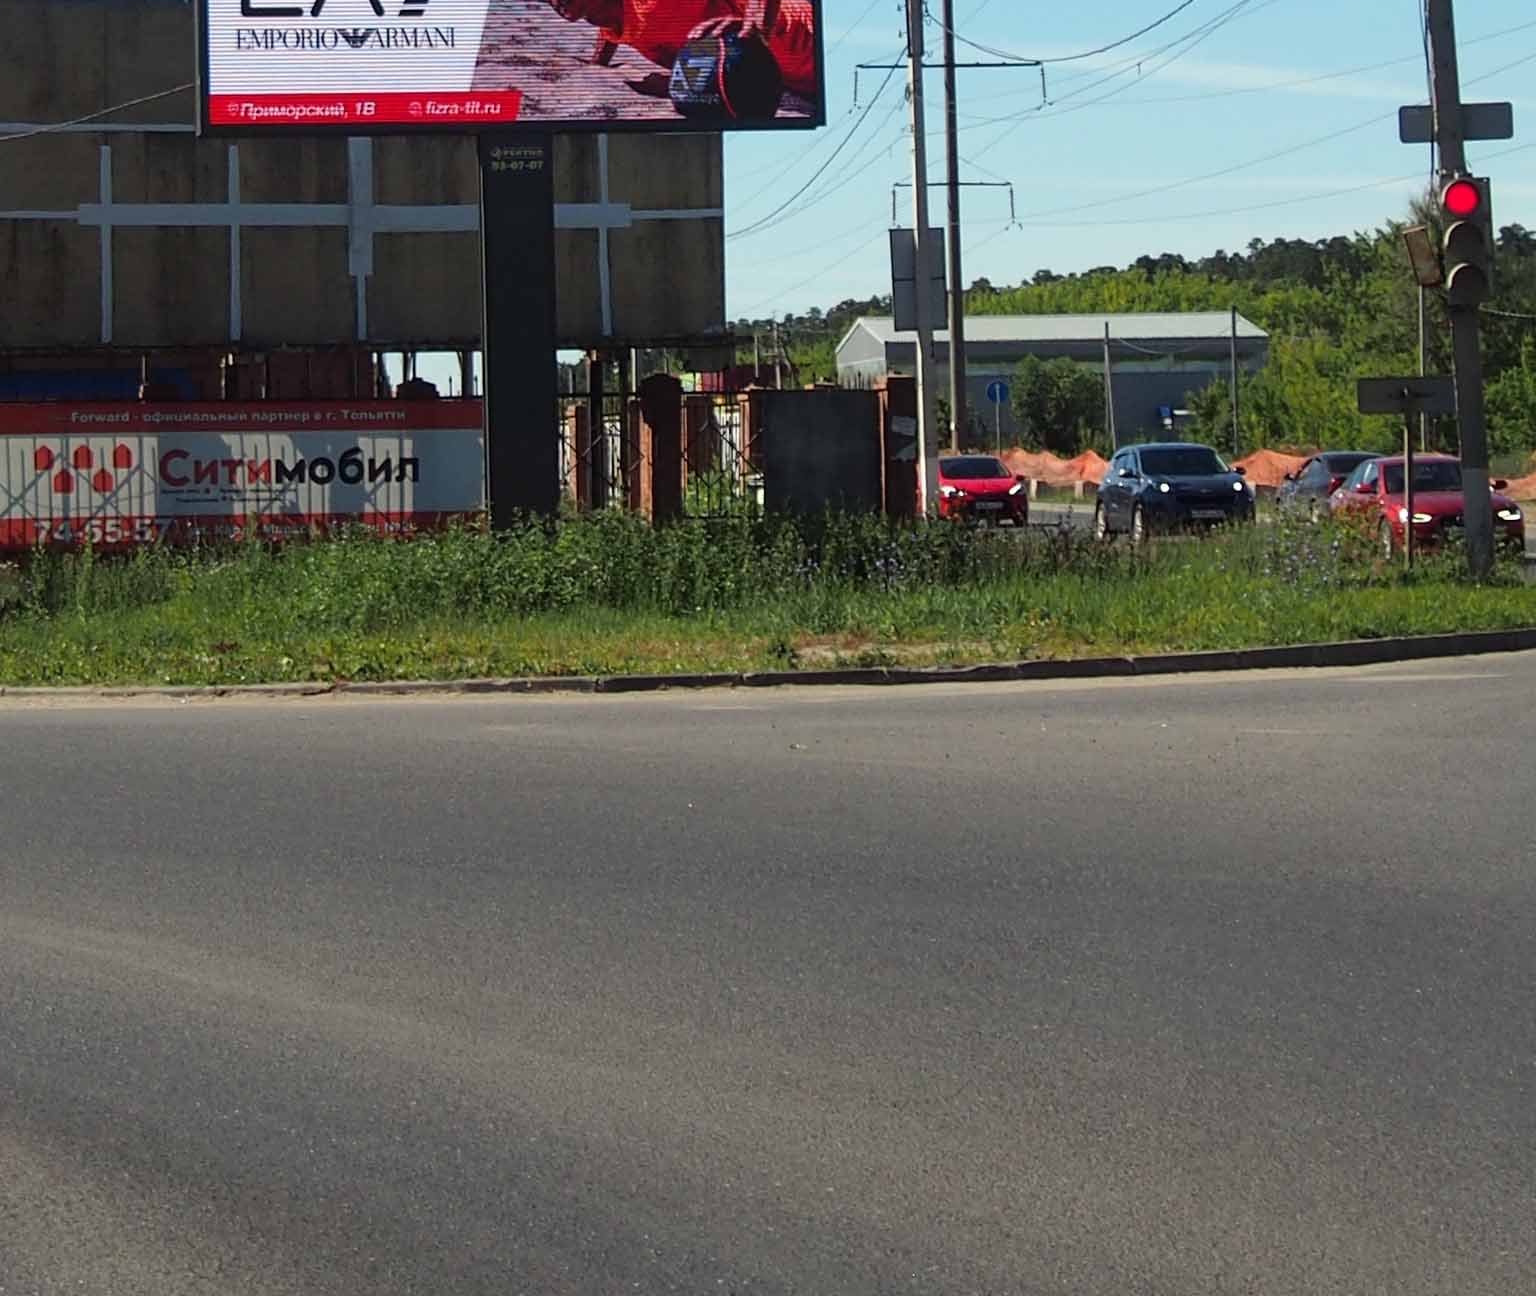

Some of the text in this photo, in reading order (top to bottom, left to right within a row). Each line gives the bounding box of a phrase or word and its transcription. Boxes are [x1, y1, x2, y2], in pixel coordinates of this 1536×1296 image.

[236, 26, 456, 50] EMPORIO ARMANI
[240, 101, 349, 119] Приморский,
[71, 411, 130, 423] Forward
[143, 410, 248, 424] официальный
[251, 410, 310, 423] партнер
[341, 408, 406, 421] Тольятти
[158, 445, 421, 487] Ситимобил
